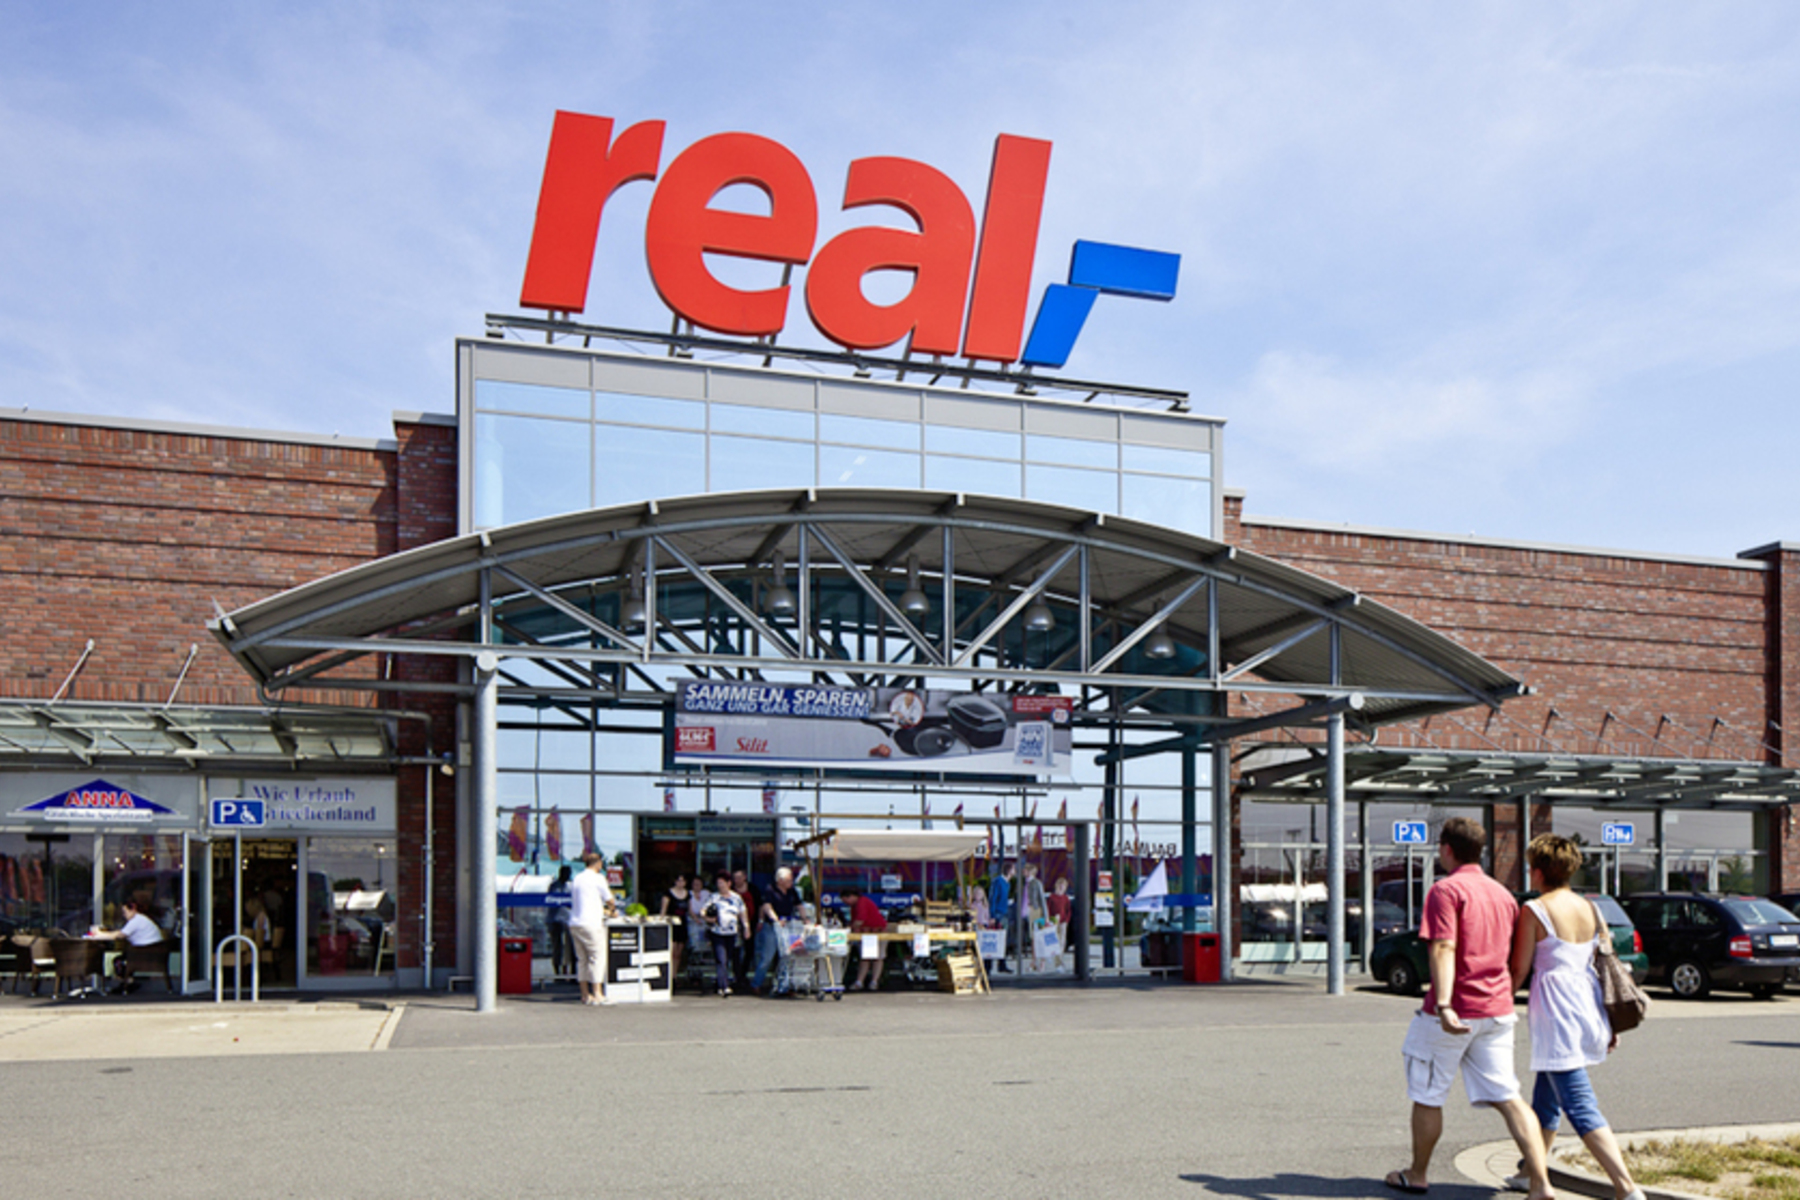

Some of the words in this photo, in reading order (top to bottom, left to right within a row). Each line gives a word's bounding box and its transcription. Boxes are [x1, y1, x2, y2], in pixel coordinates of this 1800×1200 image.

[685, 700, 724, 711] GANZ
[728, 701, 758, 712] UND
[761, 702, 790, 714] GAR
[734, 737, 770, 752] Silit
[64, 790, 135, 808] ANNA
[253, 785, 289, 801] Wie
[295, 786, 355, 803] Urlaub
[220, 802, 237, 823] P
[1399, 823, 1410, 841] P
